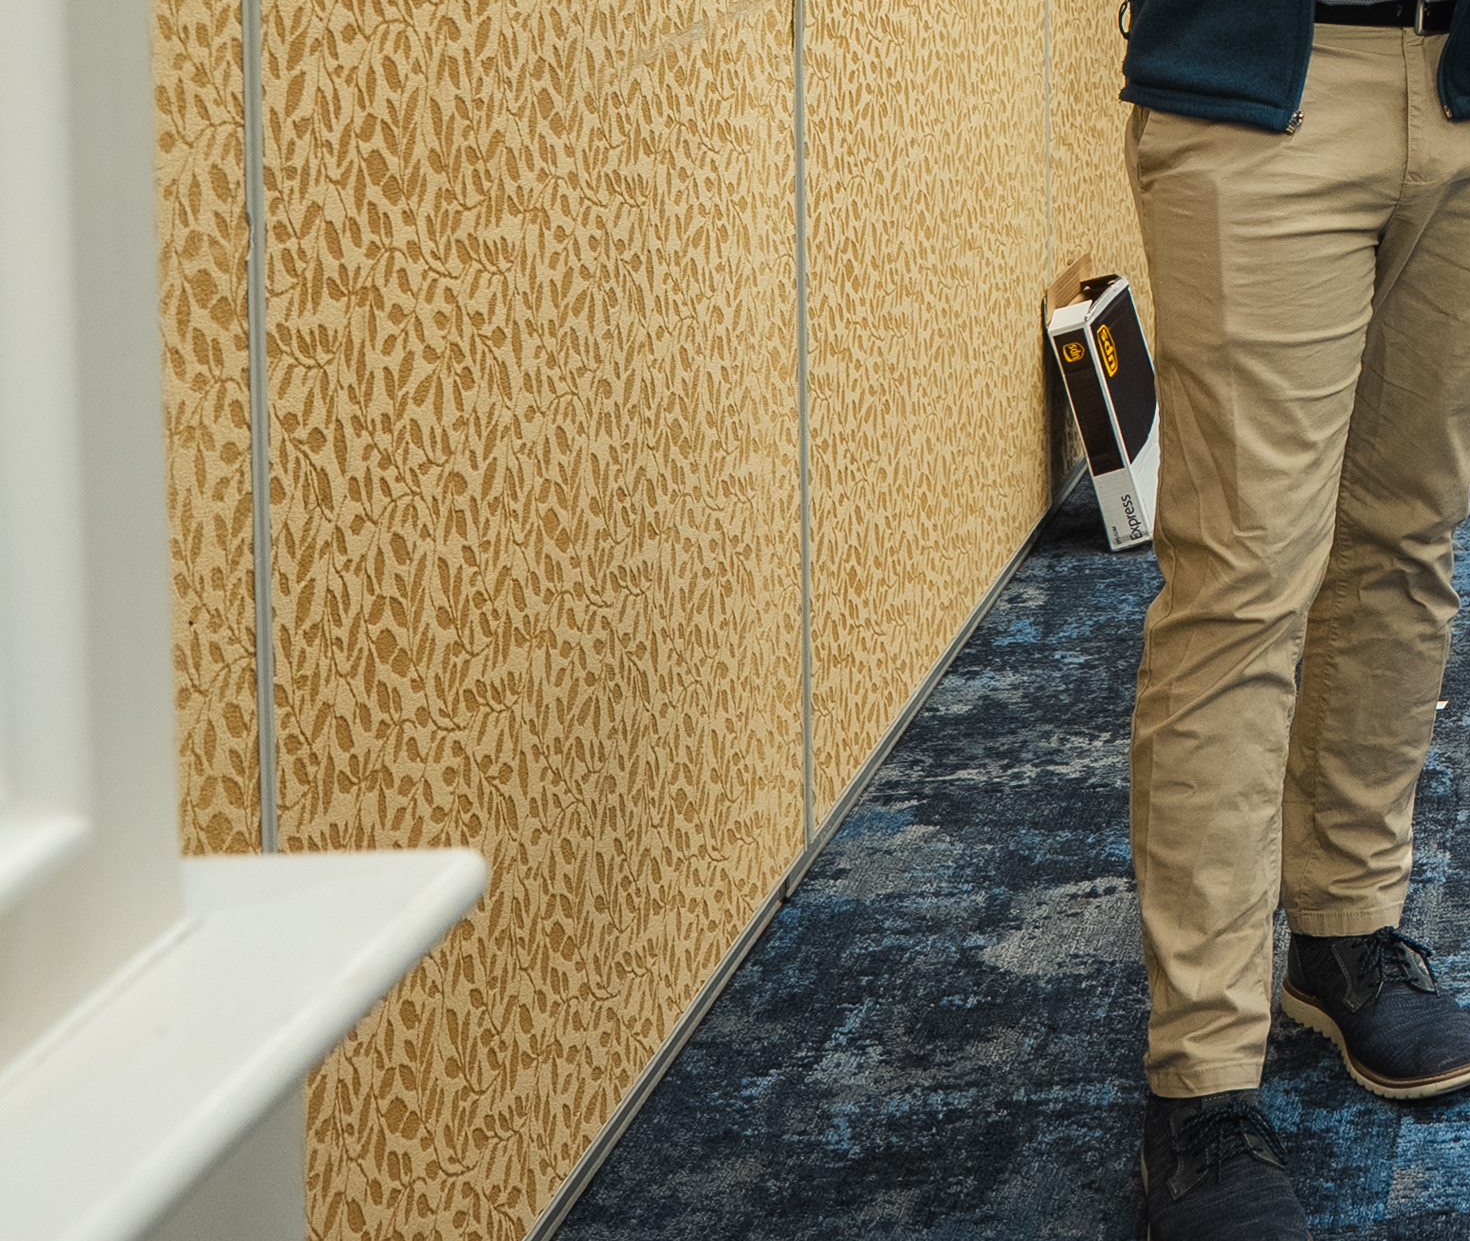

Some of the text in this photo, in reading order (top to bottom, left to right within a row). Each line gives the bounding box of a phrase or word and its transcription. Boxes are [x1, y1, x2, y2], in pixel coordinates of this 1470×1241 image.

[1069, 344, 1081, 360] ups
[1101, 329, 1115, 370] ups
[1121, 494, 1143, 540] Express
